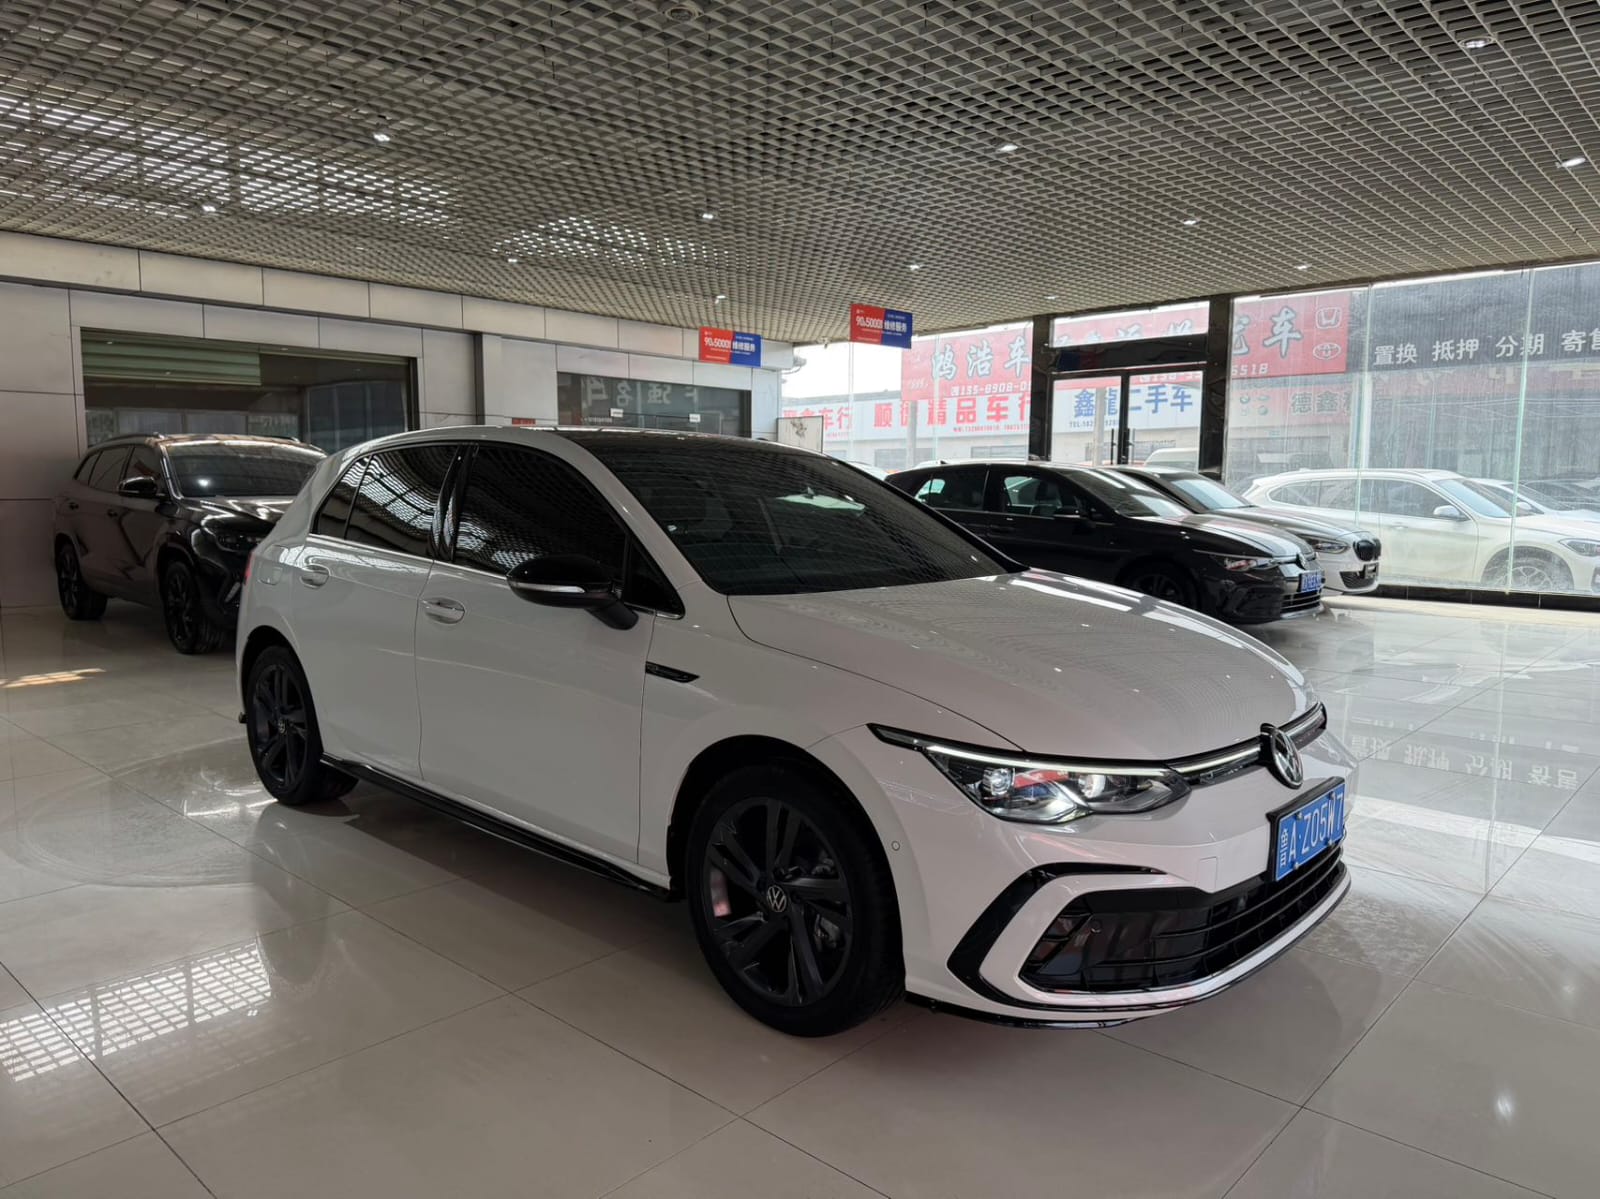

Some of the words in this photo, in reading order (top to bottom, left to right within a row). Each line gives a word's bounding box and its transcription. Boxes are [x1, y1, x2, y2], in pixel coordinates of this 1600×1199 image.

[1373, 342, 1418, 366] 置换
[1432, 338, 1480, 362] 抵押
[1495, 333, 1545, 358] 分期
